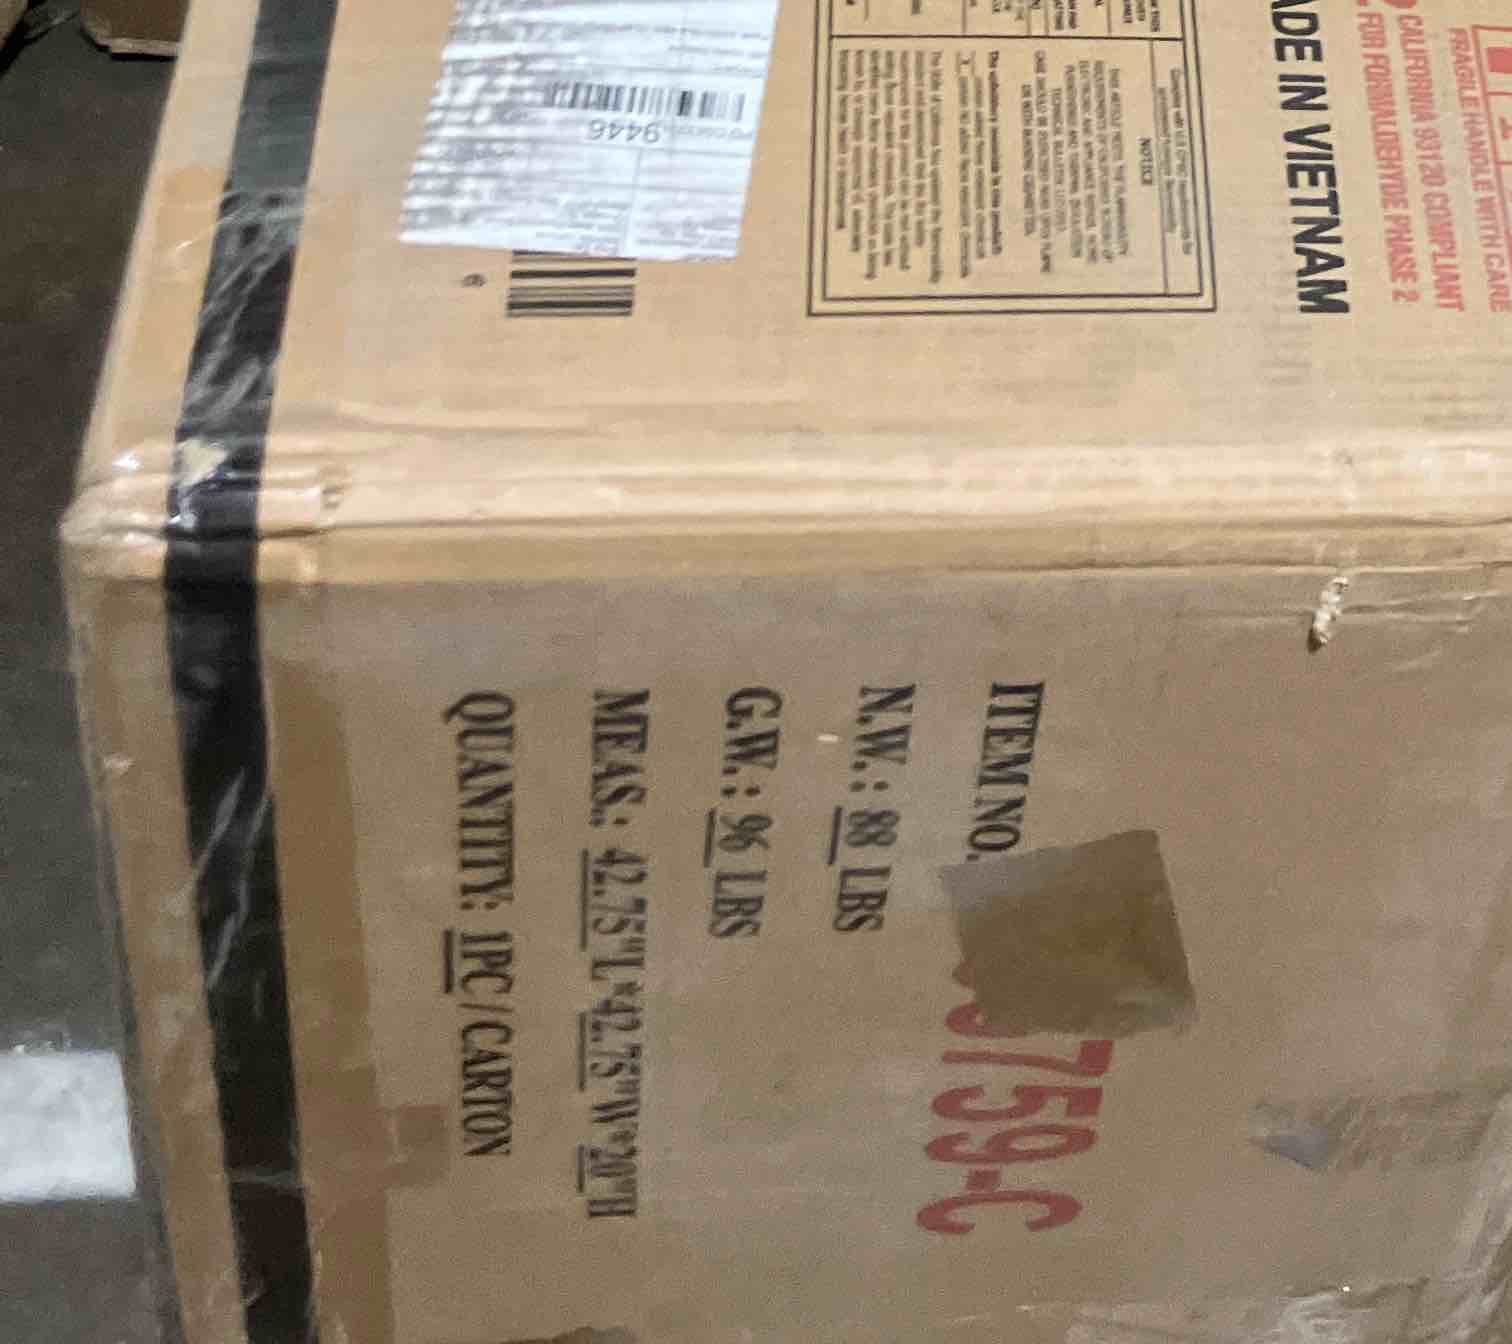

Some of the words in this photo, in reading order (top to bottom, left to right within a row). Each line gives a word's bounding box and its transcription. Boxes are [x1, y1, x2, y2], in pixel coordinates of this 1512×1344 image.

[1356, 12, 1385, 49] FOR
[1277, 72, 1330, 112] IN
[1397, 14, 1442, 124] CALIFORNIA
[1449, 28, 1480, 110] FRAGILE
[587, 119, 662, 144] 9446
[1361, 52, 1410, 211] FORMALDEHYDE
[1412, 127, 1447, 186] 93120
[1465, 112, 1502, 194] HANDLE
[1282, 123, 1351, 314] VIETNAM
[1383, 214, 1418, 284] PHASE
[1421, 192, 1464, 312] COMPLIANT
[1476, 196, 1506, 248] WITH
[1392, 288, 1422, 303] 2
[1485, 252, 1512, 313] CARE
[588, 688, 651, 827] MEAS.:
[720, 685, 784, 798] G.W.:
[849, 683, 917, 794] N.W.:
[978, 681, 1045, 787] ITEM
[442, 690, 515, 913] QUANTITY:
[715, 812, 774, 853] 96
[845, 808, 901, 849] 88
[708, 869, 768, 940] LBS
[832, 866, 896, 933] LBS
[915, 960, 1114, 1235] 759-C
